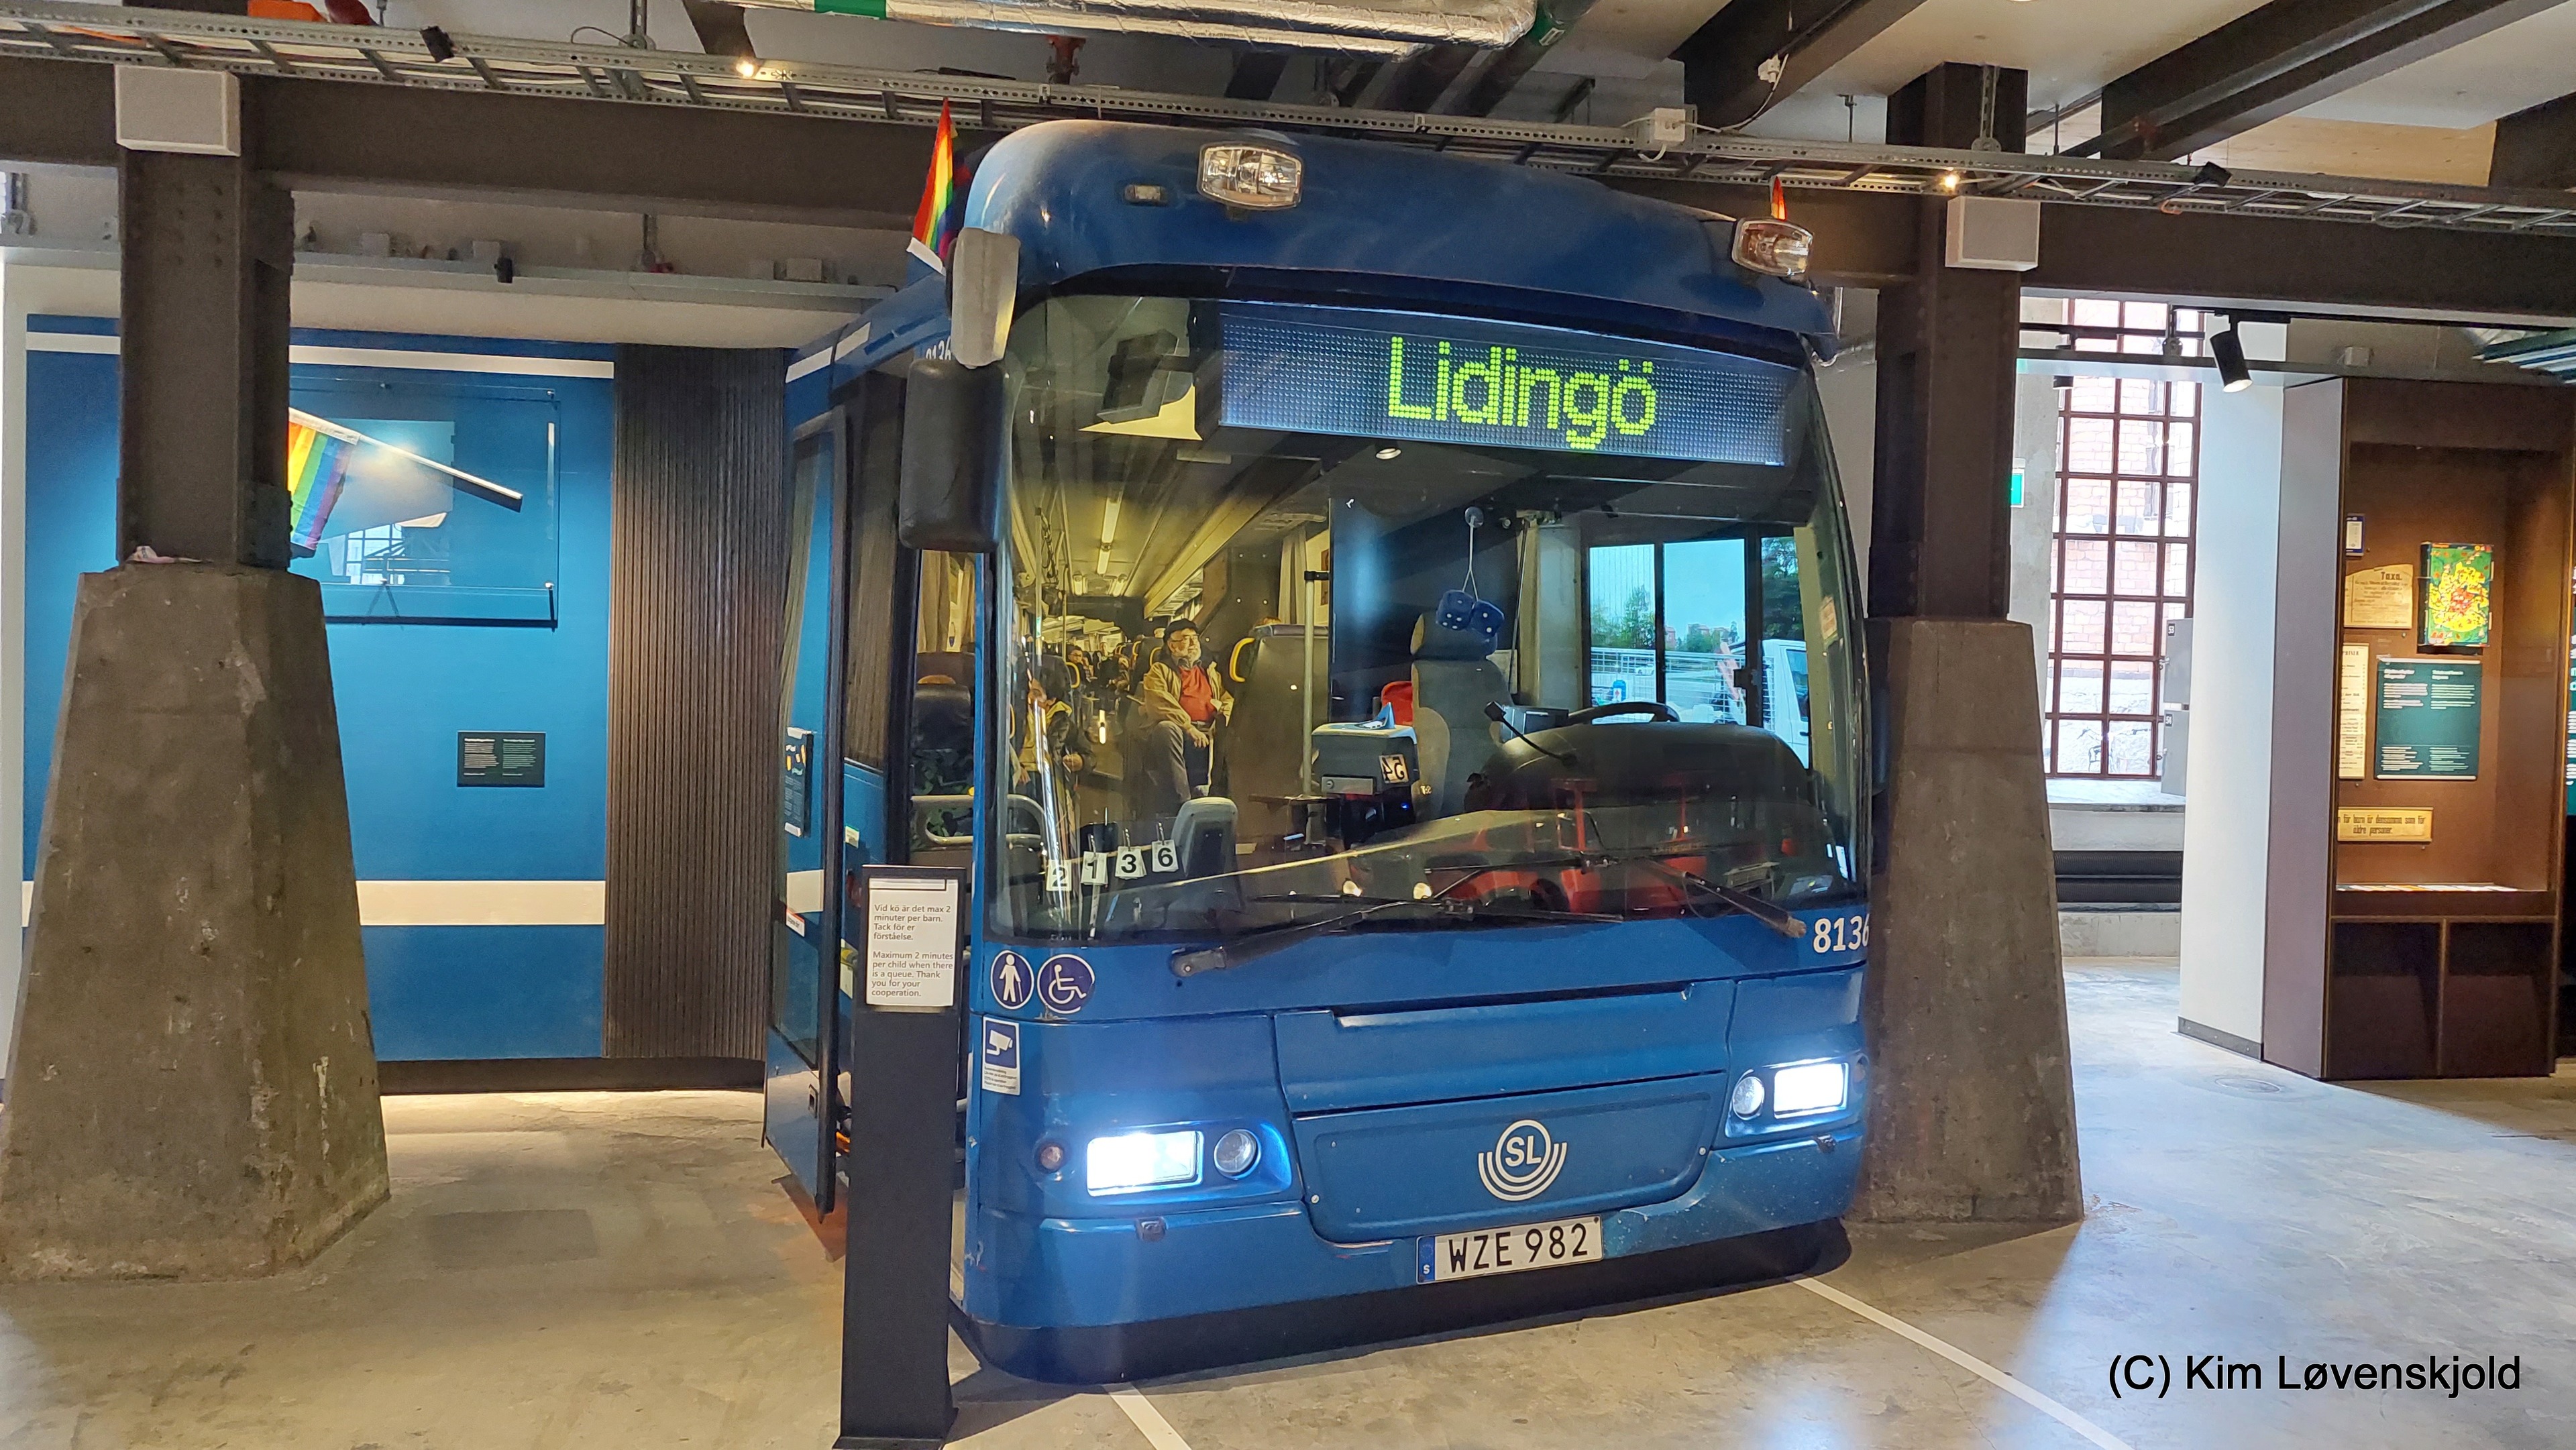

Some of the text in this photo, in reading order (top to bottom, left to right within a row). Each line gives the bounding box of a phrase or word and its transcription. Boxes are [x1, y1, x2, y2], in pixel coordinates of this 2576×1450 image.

[1388, 336, 1657, 451] Lidingö
[1052, 847, 1173, 887] 2 1 3 6
[1813, 913, 1870, 953] 8136
[871, 989, 921, 997] cooperation.
[1505, 1135, 1542, 1166] SL
[1448, 1223, 1588, 1273] WZE 982
[1424, 1264, 1430, 1274] S
